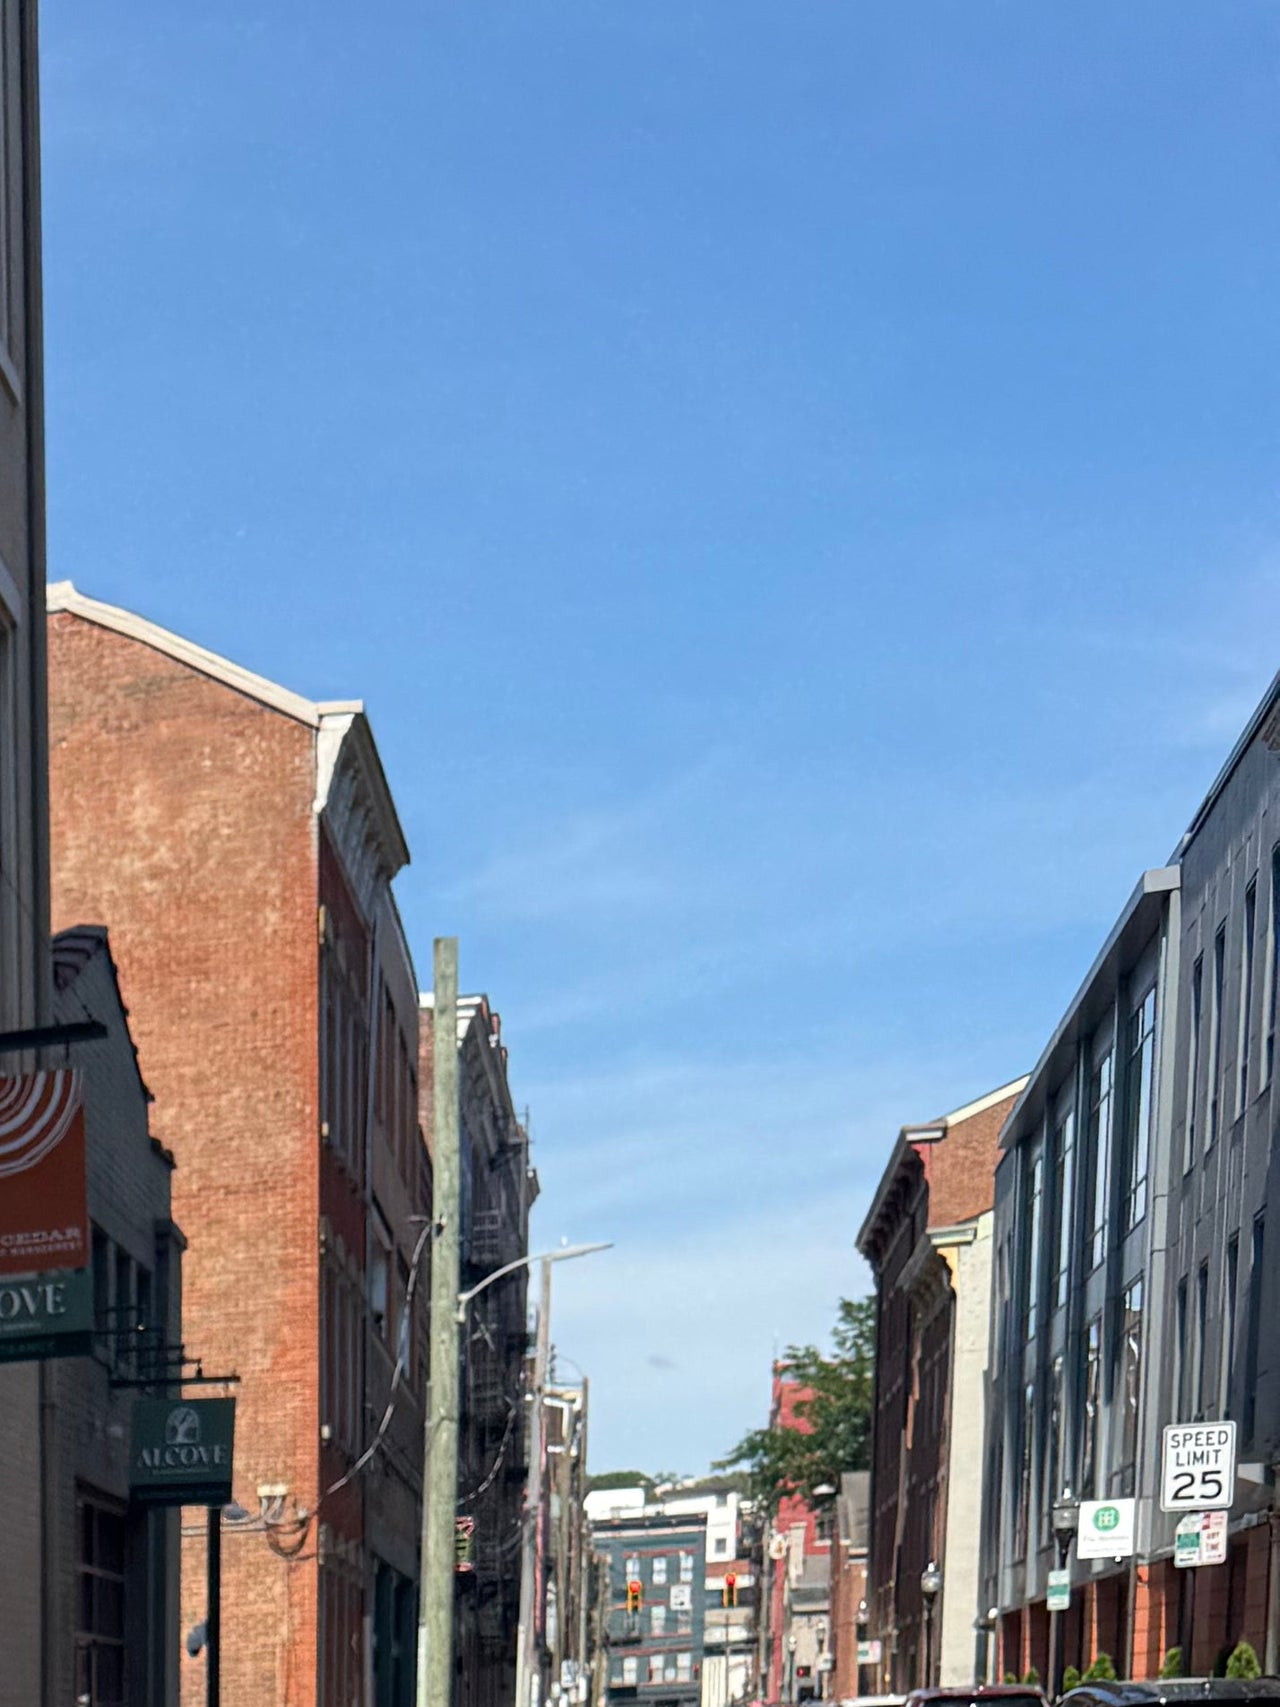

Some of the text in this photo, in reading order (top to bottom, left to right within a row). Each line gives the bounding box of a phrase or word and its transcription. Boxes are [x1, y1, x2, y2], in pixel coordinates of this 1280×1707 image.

[0, 1227, 81, 1247] CEDAR
[1171, 1430, 1228, 1448] SPEED
[137, 1445, 227, 1468] ALCOVE
[1176, 1449, 1222, 1466] LIMIT
[1172, 1470, 1222, 1501] 25
